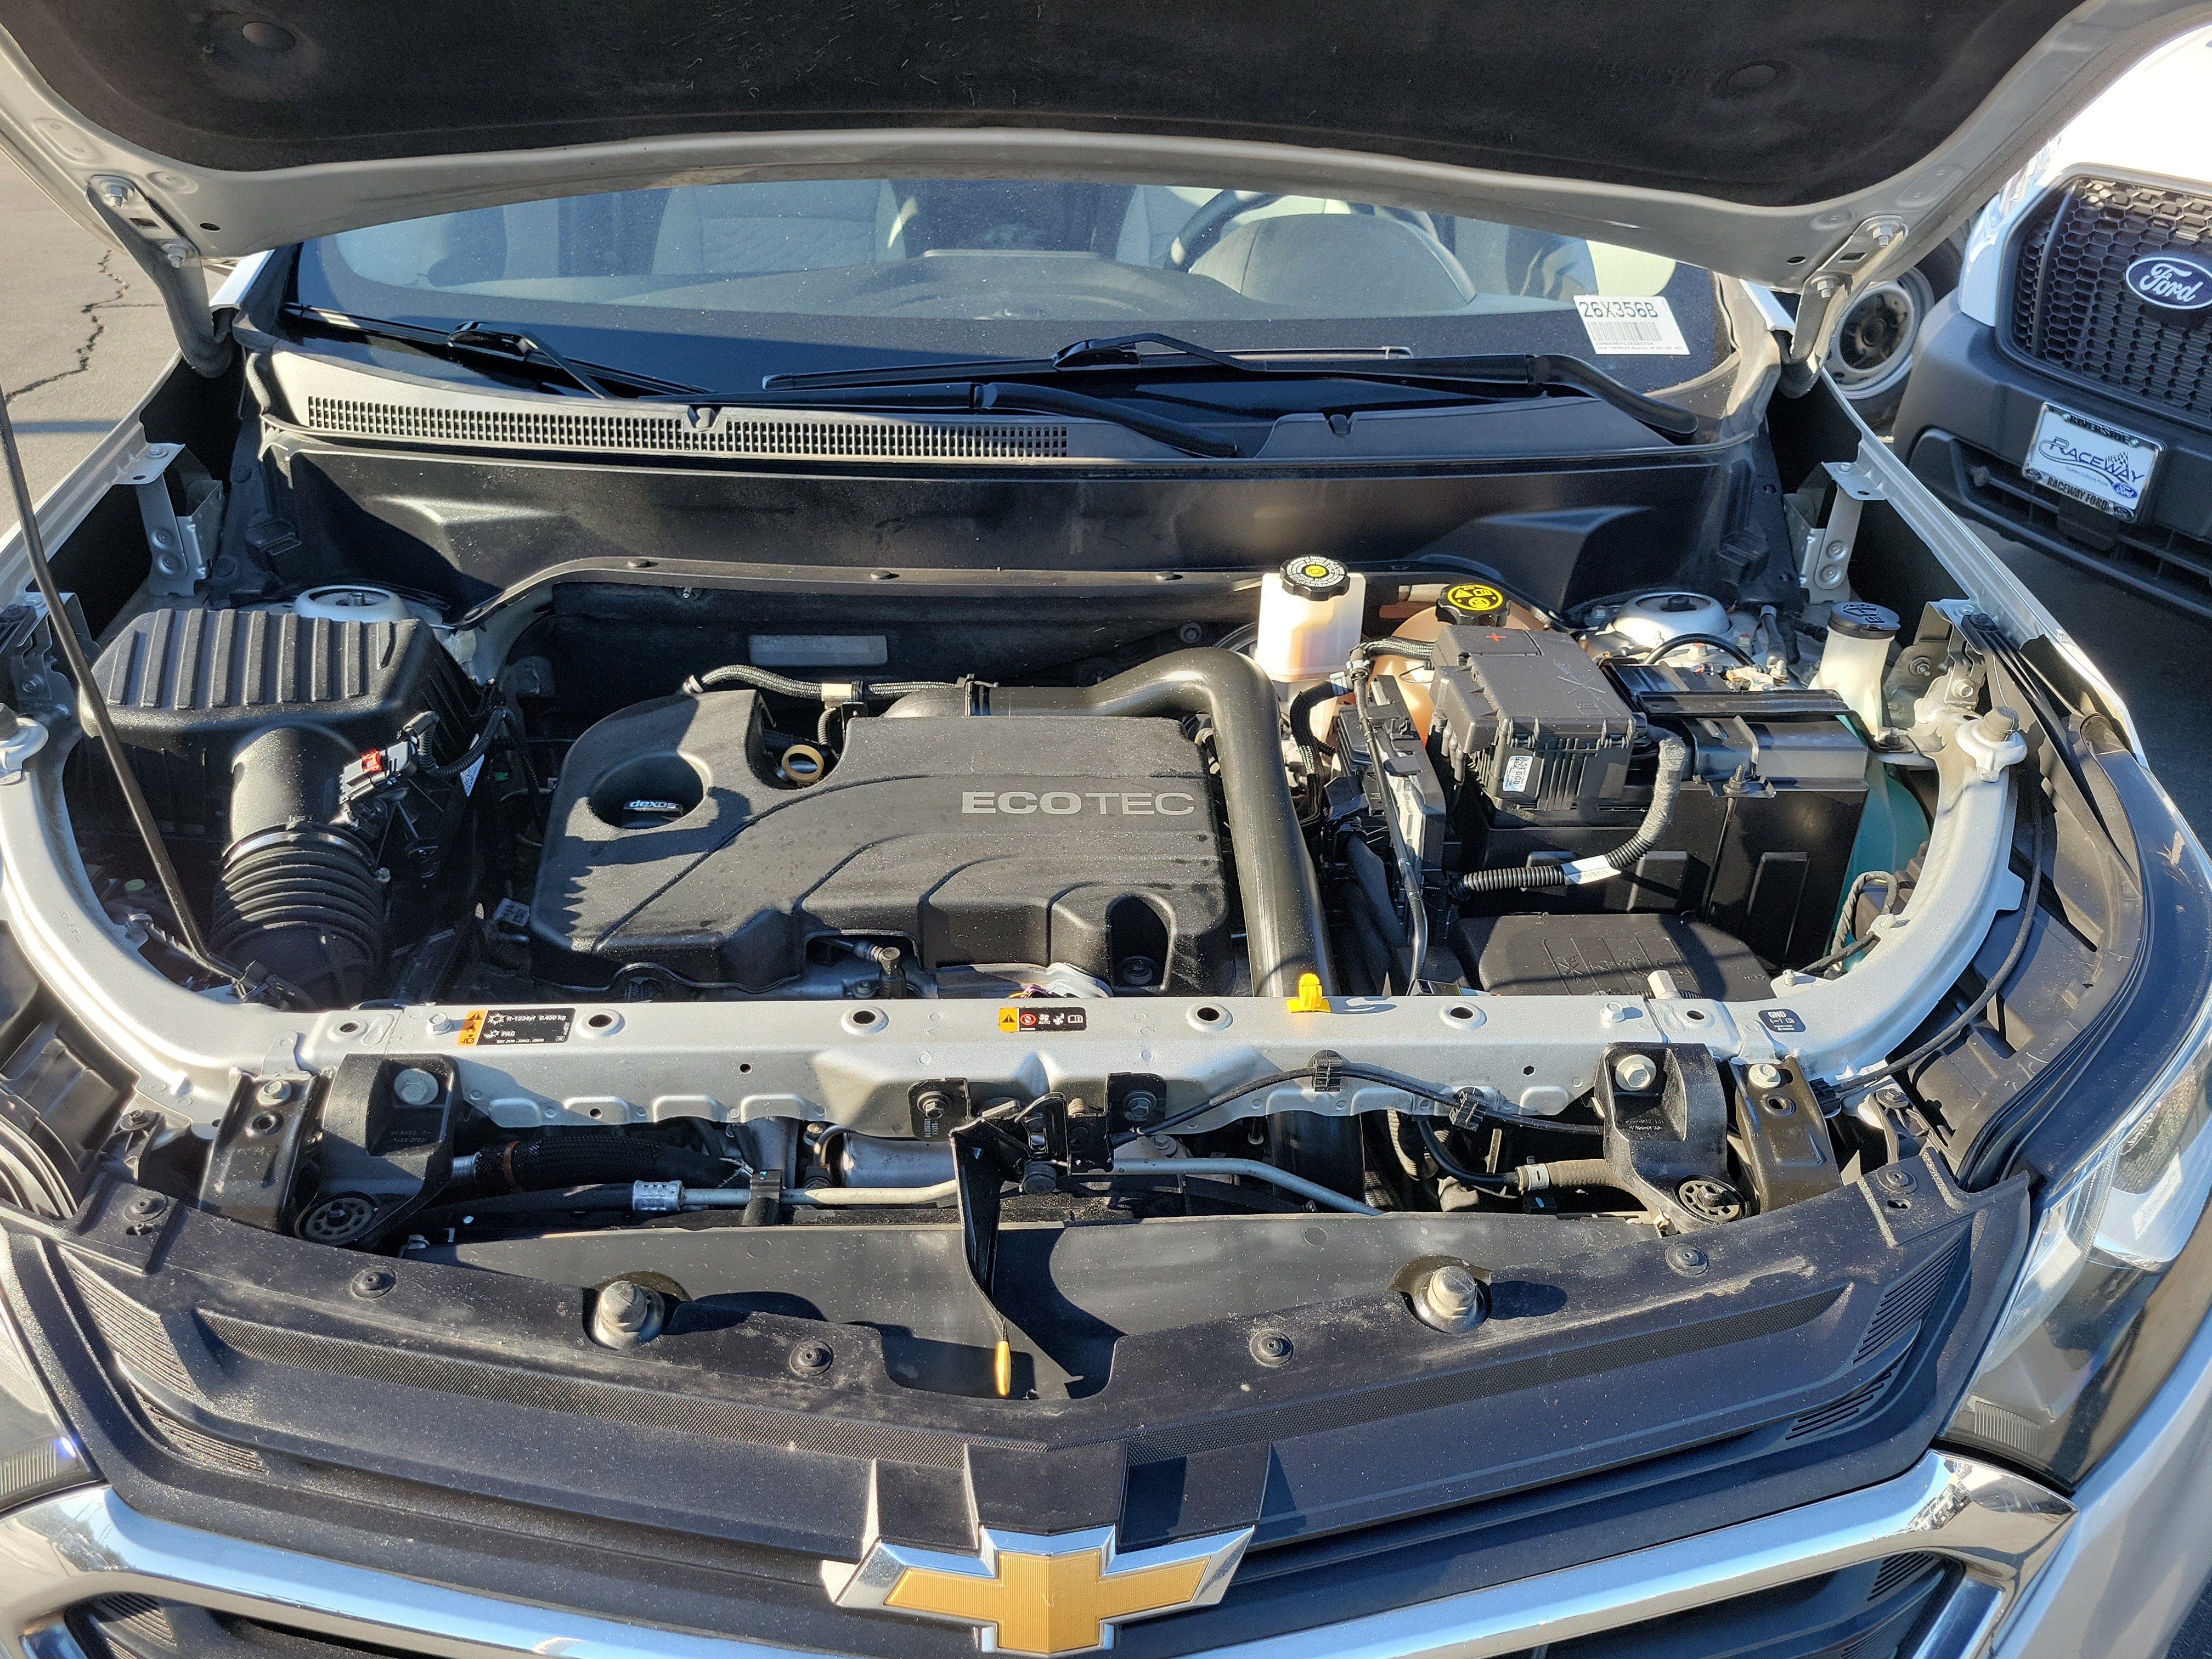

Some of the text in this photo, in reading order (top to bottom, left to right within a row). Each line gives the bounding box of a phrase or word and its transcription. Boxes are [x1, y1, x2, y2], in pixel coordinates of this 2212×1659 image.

[2140, 263, 2204, 302] Ford
[1579, 301, 1658, 318] 26X356B
[2070, 415, 2130, 442] RIVERSIDE
[2050, 437, 2145, 482] RACEWAY
[2047, 477, 2108, 510] RACEWAY FORD
[629, 800, 678, 809] dexos
[962, 791, 1195, 815] ECOTEC
